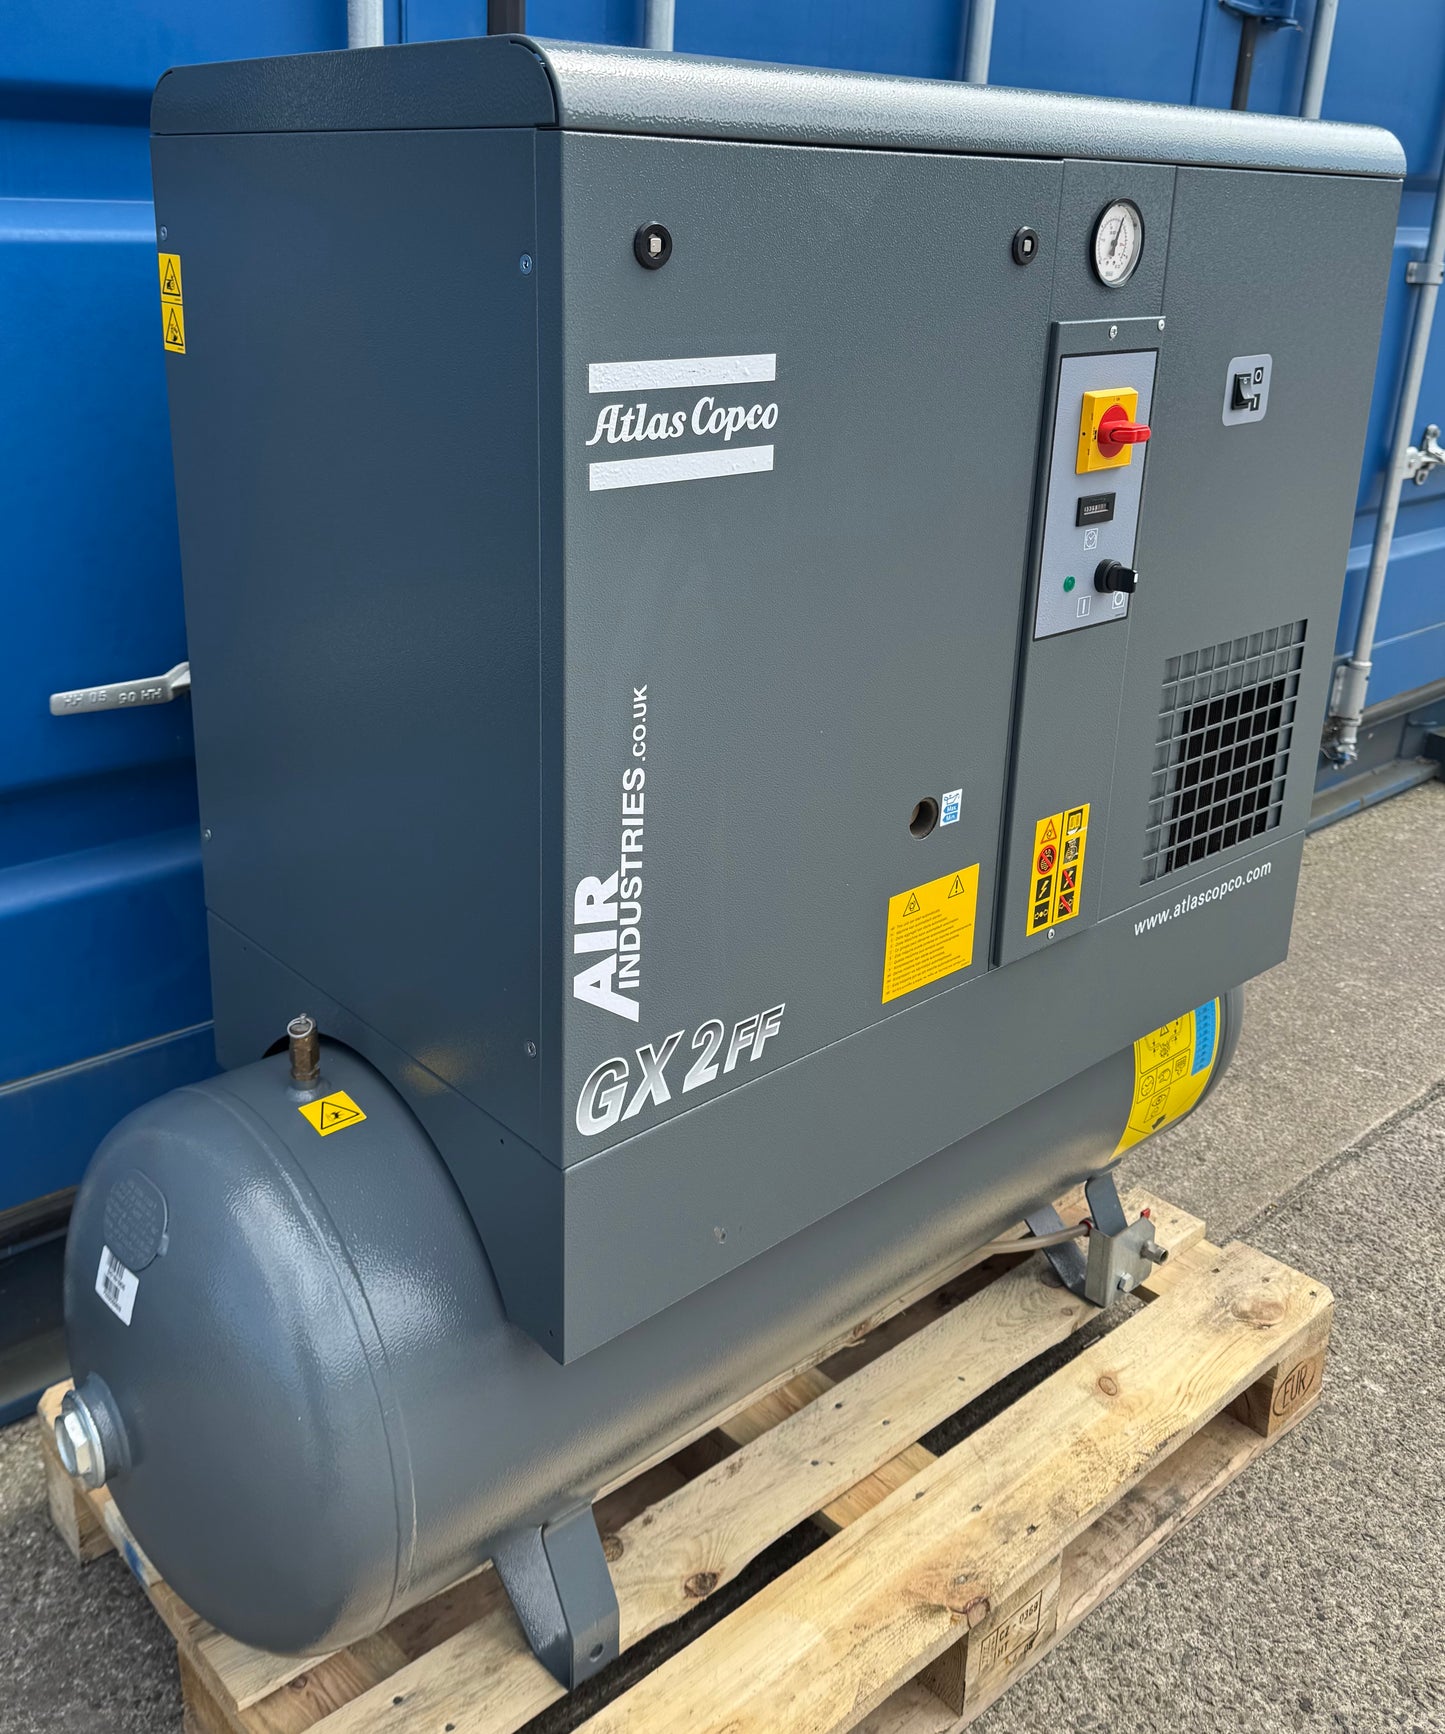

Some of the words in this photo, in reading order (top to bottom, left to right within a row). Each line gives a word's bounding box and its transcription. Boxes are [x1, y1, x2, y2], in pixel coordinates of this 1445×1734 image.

[586, 403, 687, 446] Atlas
[691, 396, 779, 441] Copco
[618, 767, 646, 989] INDUSTRIES
[1134, 861, 1272, 936] www.atlascopco.com
[573, 870, 640, 1023] AIR
[576, 1029, 686, 1136] GX
[1283, 1364, 1308, 1409] EUR
